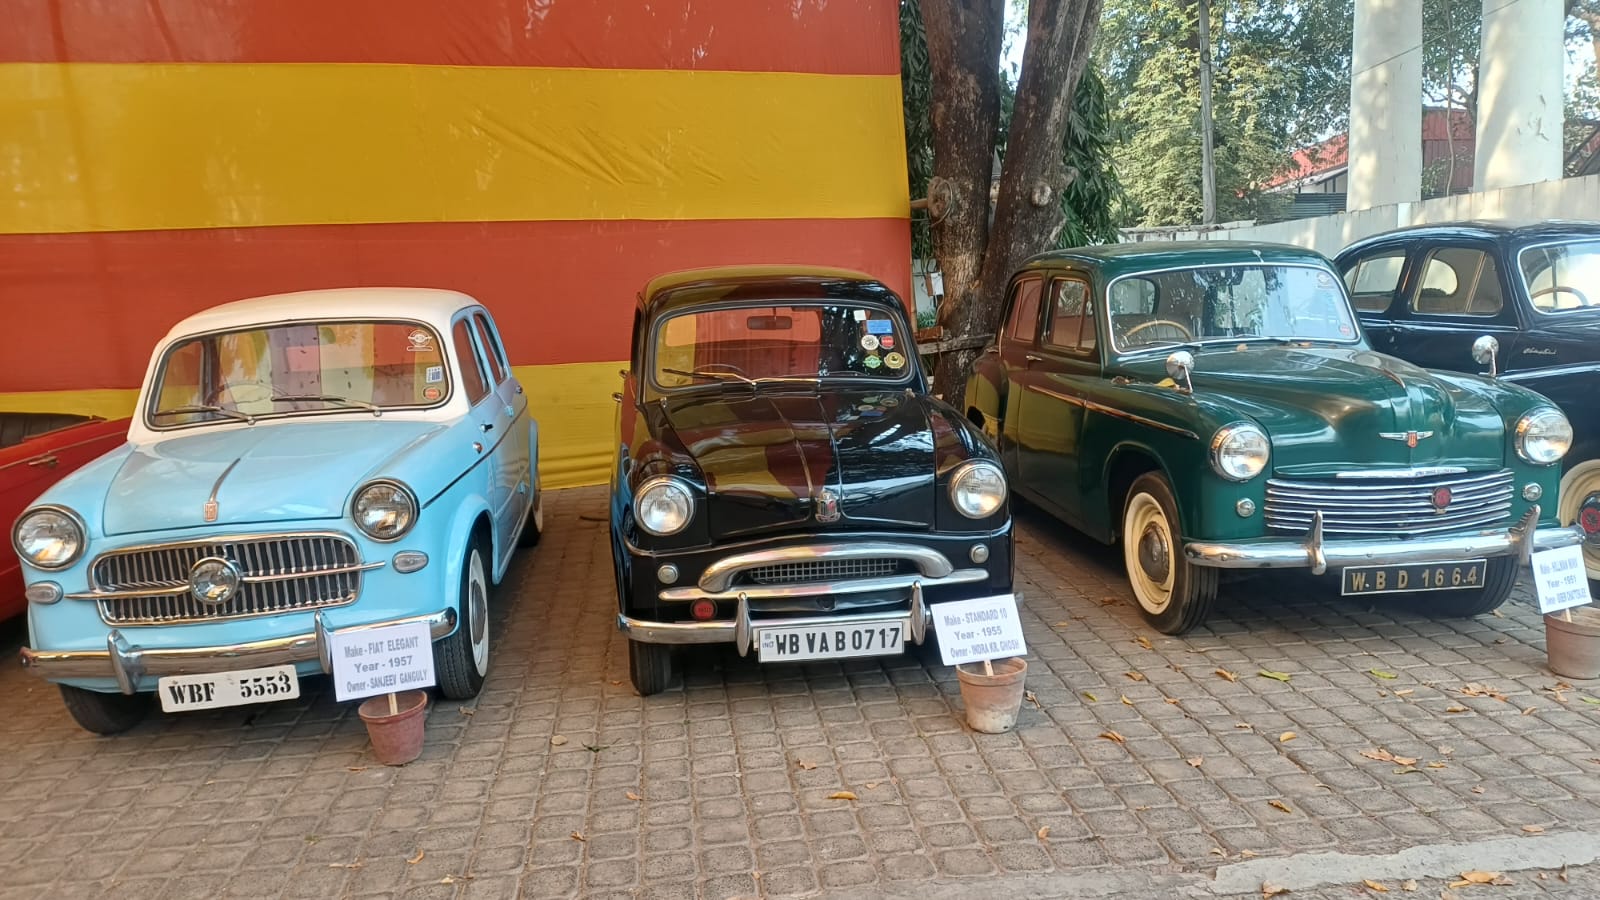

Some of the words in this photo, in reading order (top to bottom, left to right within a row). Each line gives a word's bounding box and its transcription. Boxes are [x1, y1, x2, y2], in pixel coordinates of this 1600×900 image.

[944, 614, 962, 626] Make
[965, 608, 999, 624] STANDARD
[999, 607, 1008, 619] 10
[954, 631, 975, 641] Year
[982, 625, 1002, 637] 1955
[344, 645, 364, 658] Make
[368, 641, 384, 655] FIAT
[387, 636, 419, 652] ELEGANT
[950, 647, 968, 658] Owner
[971, 643, 990, 656] INDRA
[999, 639, 1020, 651] GHOSH
[354, 662, 379, 673] Year
[388, 655, 413, 668] 1957
[168, 682, 215, 705] WBF
[240, 673, 292, 698] 5553
[346, 680, 366, 693] Owner
[370, 674, 397, 689] SANJEEV
[400, 669, 428, 684] GANGULY
